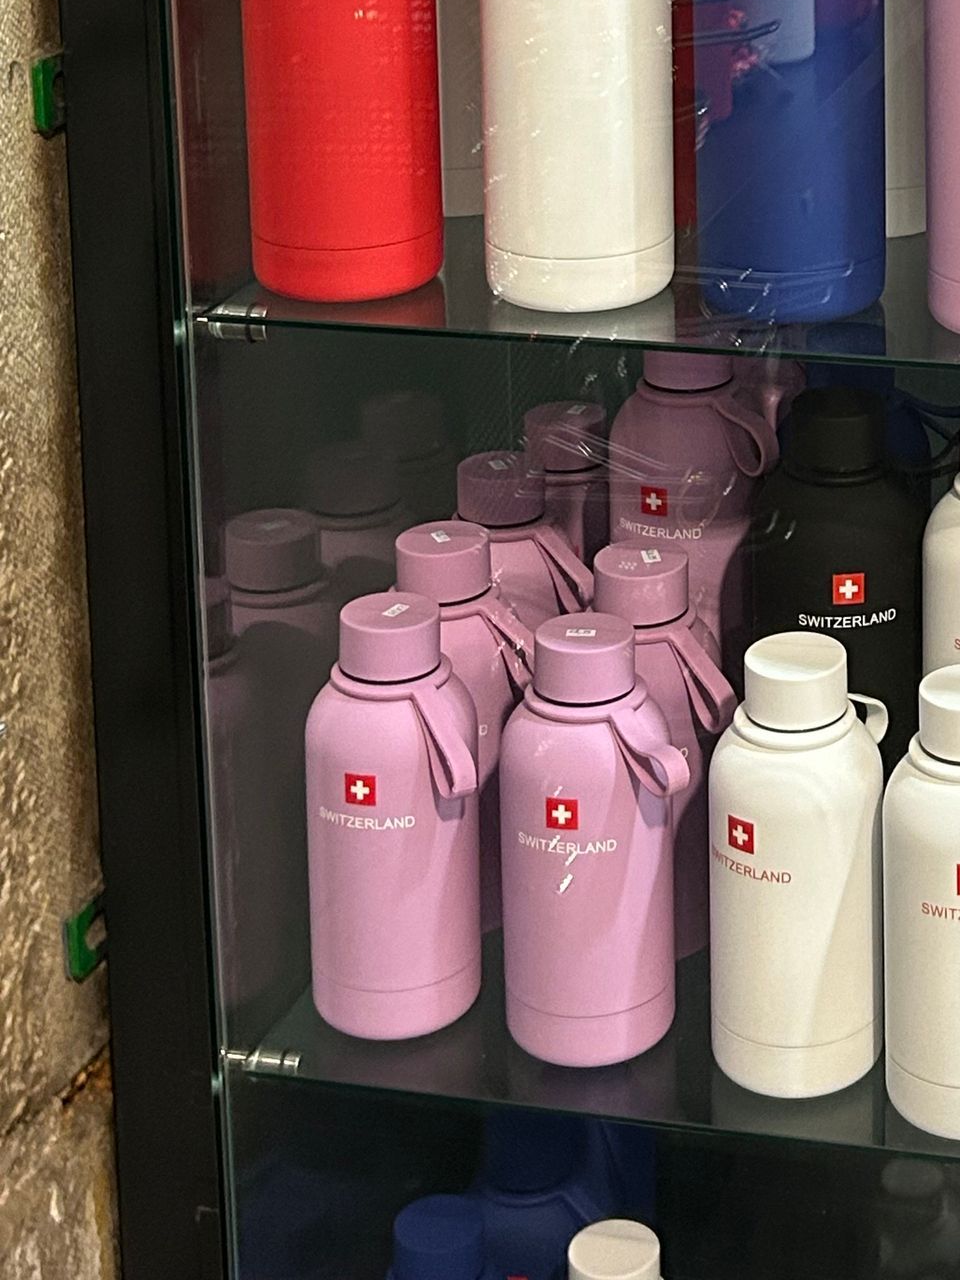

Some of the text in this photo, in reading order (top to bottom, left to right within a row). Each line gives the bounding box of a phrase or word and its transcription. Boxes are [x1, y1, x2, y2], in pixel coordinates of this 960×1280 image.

[620, 517, 701, 540] SWITZERLAND
[798, 607, 896, 629] SWITZERLAND
[320, 806, 416, 831] SWITZERLAND
[518, 831, 617, 855] SWITZERLAND
